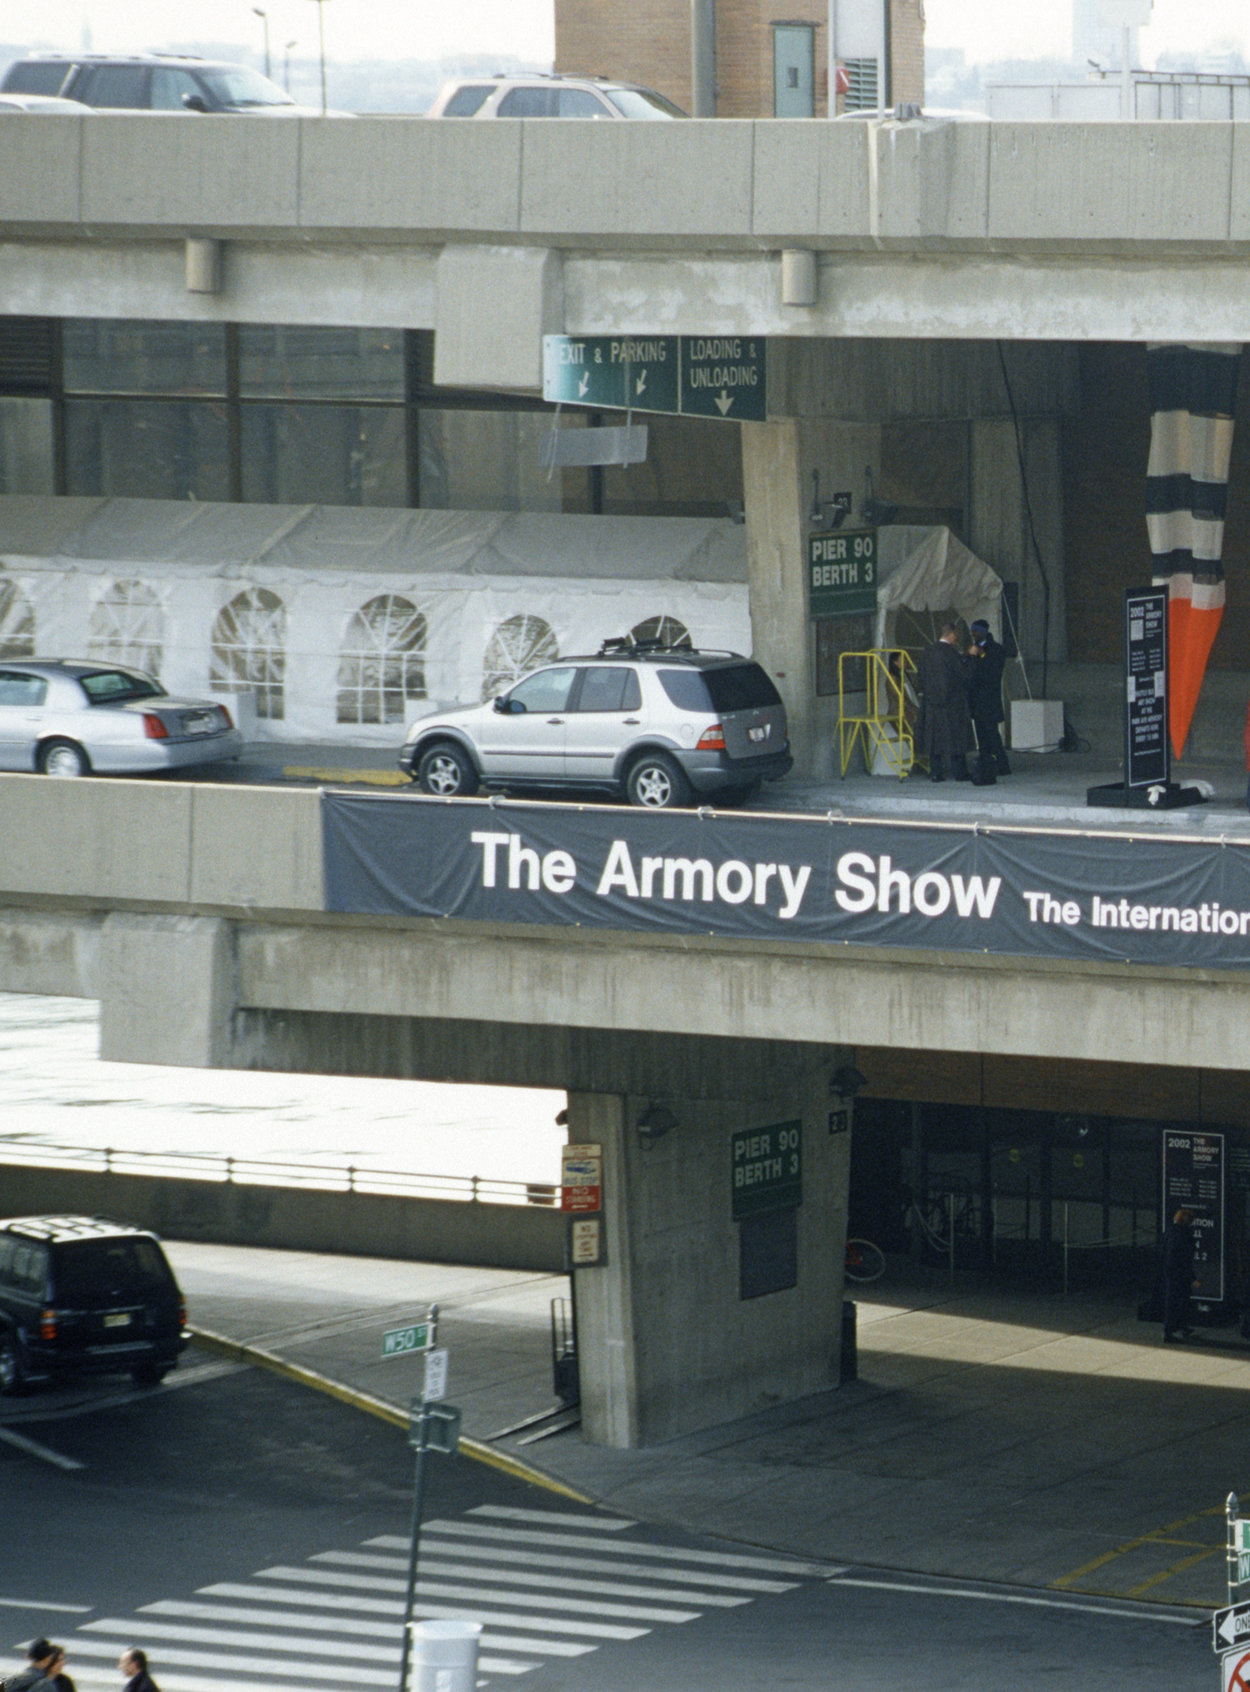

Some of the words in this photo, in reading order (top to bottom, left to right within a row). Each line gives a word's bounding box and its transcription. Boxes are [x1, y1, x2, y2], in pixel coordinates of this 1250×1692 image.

[560, 343, 585, 365] EXIT
[594, 347, 602, 363] &
[611, 341, 667, 363] PARKING
[691, 339, 742, 360] LOADING
[750, 343, 757, 358] &
[691, 366, 759, 388] UNLOADING
[812, 539, 847, 562] PIER
[854, 537, 873, 558] 90
[812, 562, 858, 587] BERTH
[865, 562, 873, 583] 3
[471, 831, 577, 894] The
[596, 839, 811, 919] Armory
[835, 852, 1001, 918] Show
[1023, 891, 1081, 925] The
[735, 1134, 770, 1161] PIER
[778, 1129, 799, 1151] 90
[1168, 1137, 1190, 1149] 2002
[1193, 1137, 1206, 1145] THE
[1193, 1145, 1219, 1154] ARMORY
[1193, 1153, 1212, 1162] SHOW
[735, 1157, 782, 1187] BERTH
[791, 1153, 799, 1174] 3
[385, 1328, 416, 1354] W50
